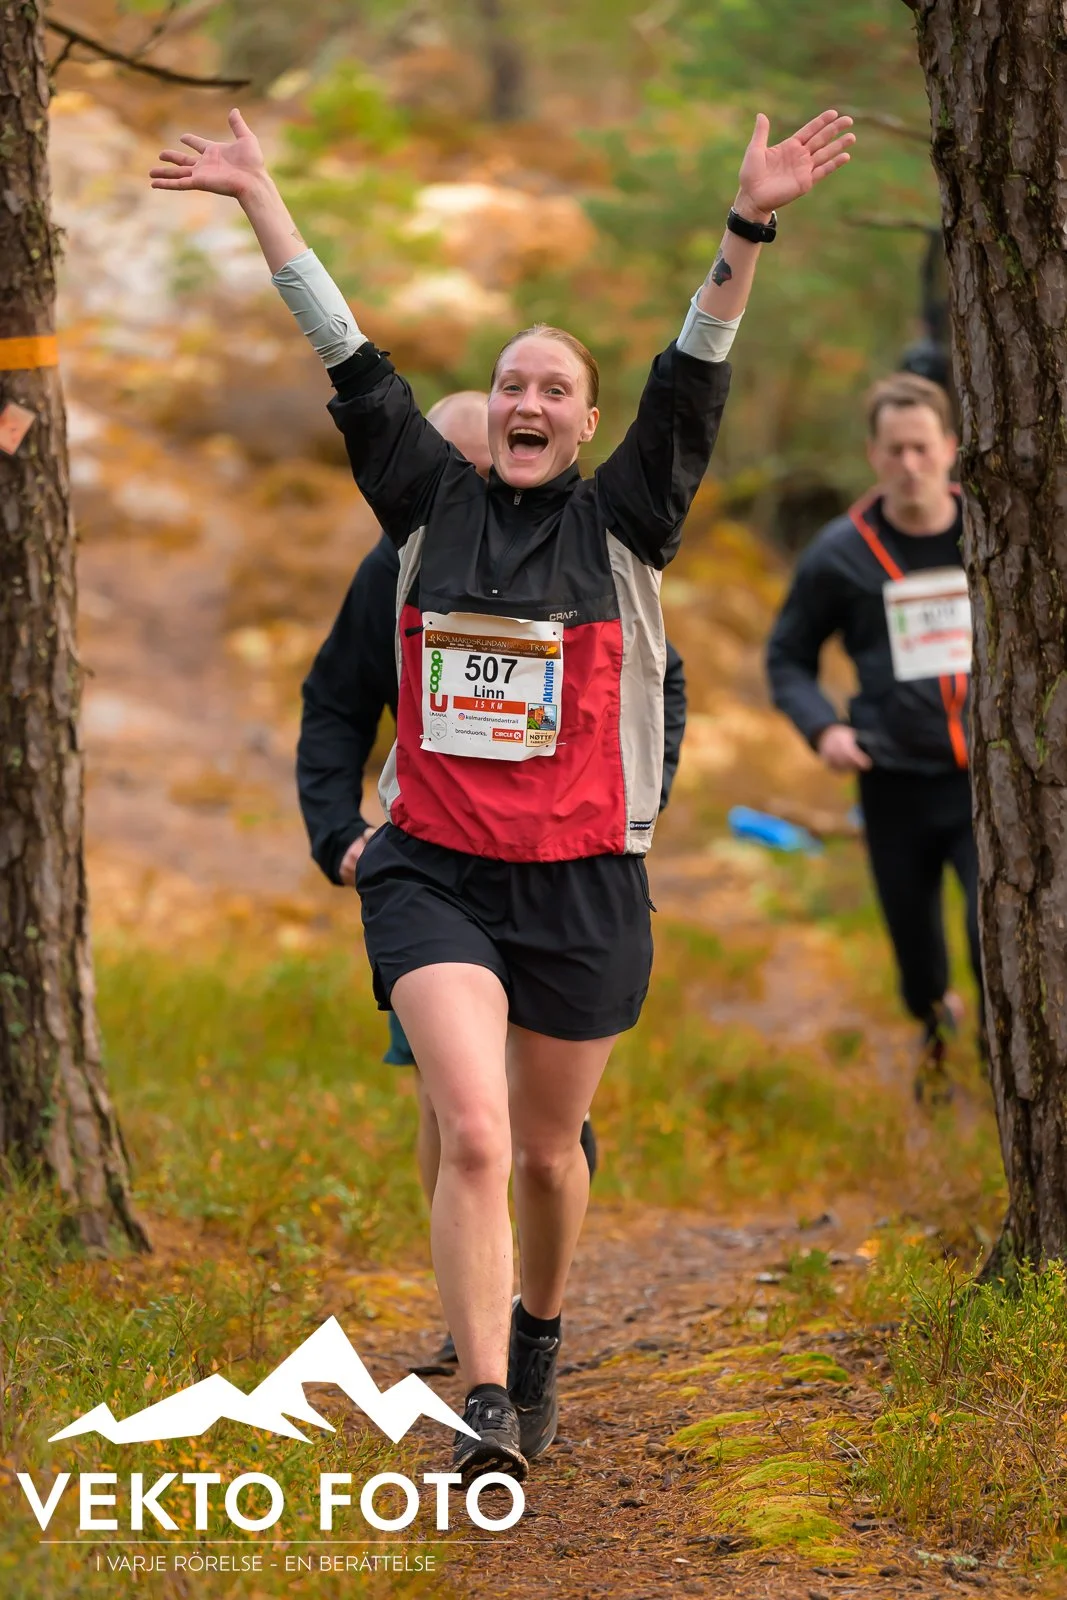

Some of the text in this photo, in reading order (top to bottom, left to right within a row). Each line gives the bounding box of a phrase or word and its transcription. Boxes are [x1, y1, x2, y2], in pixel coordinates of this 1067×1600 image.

[430, 650, 441, 693] coop
[465, 654, 518, 684] 507
[543, 660, 554, 703] Aktivitus
[474, 684, 505, 699] Linn
[474, 699, 503, 710] 15 KM
